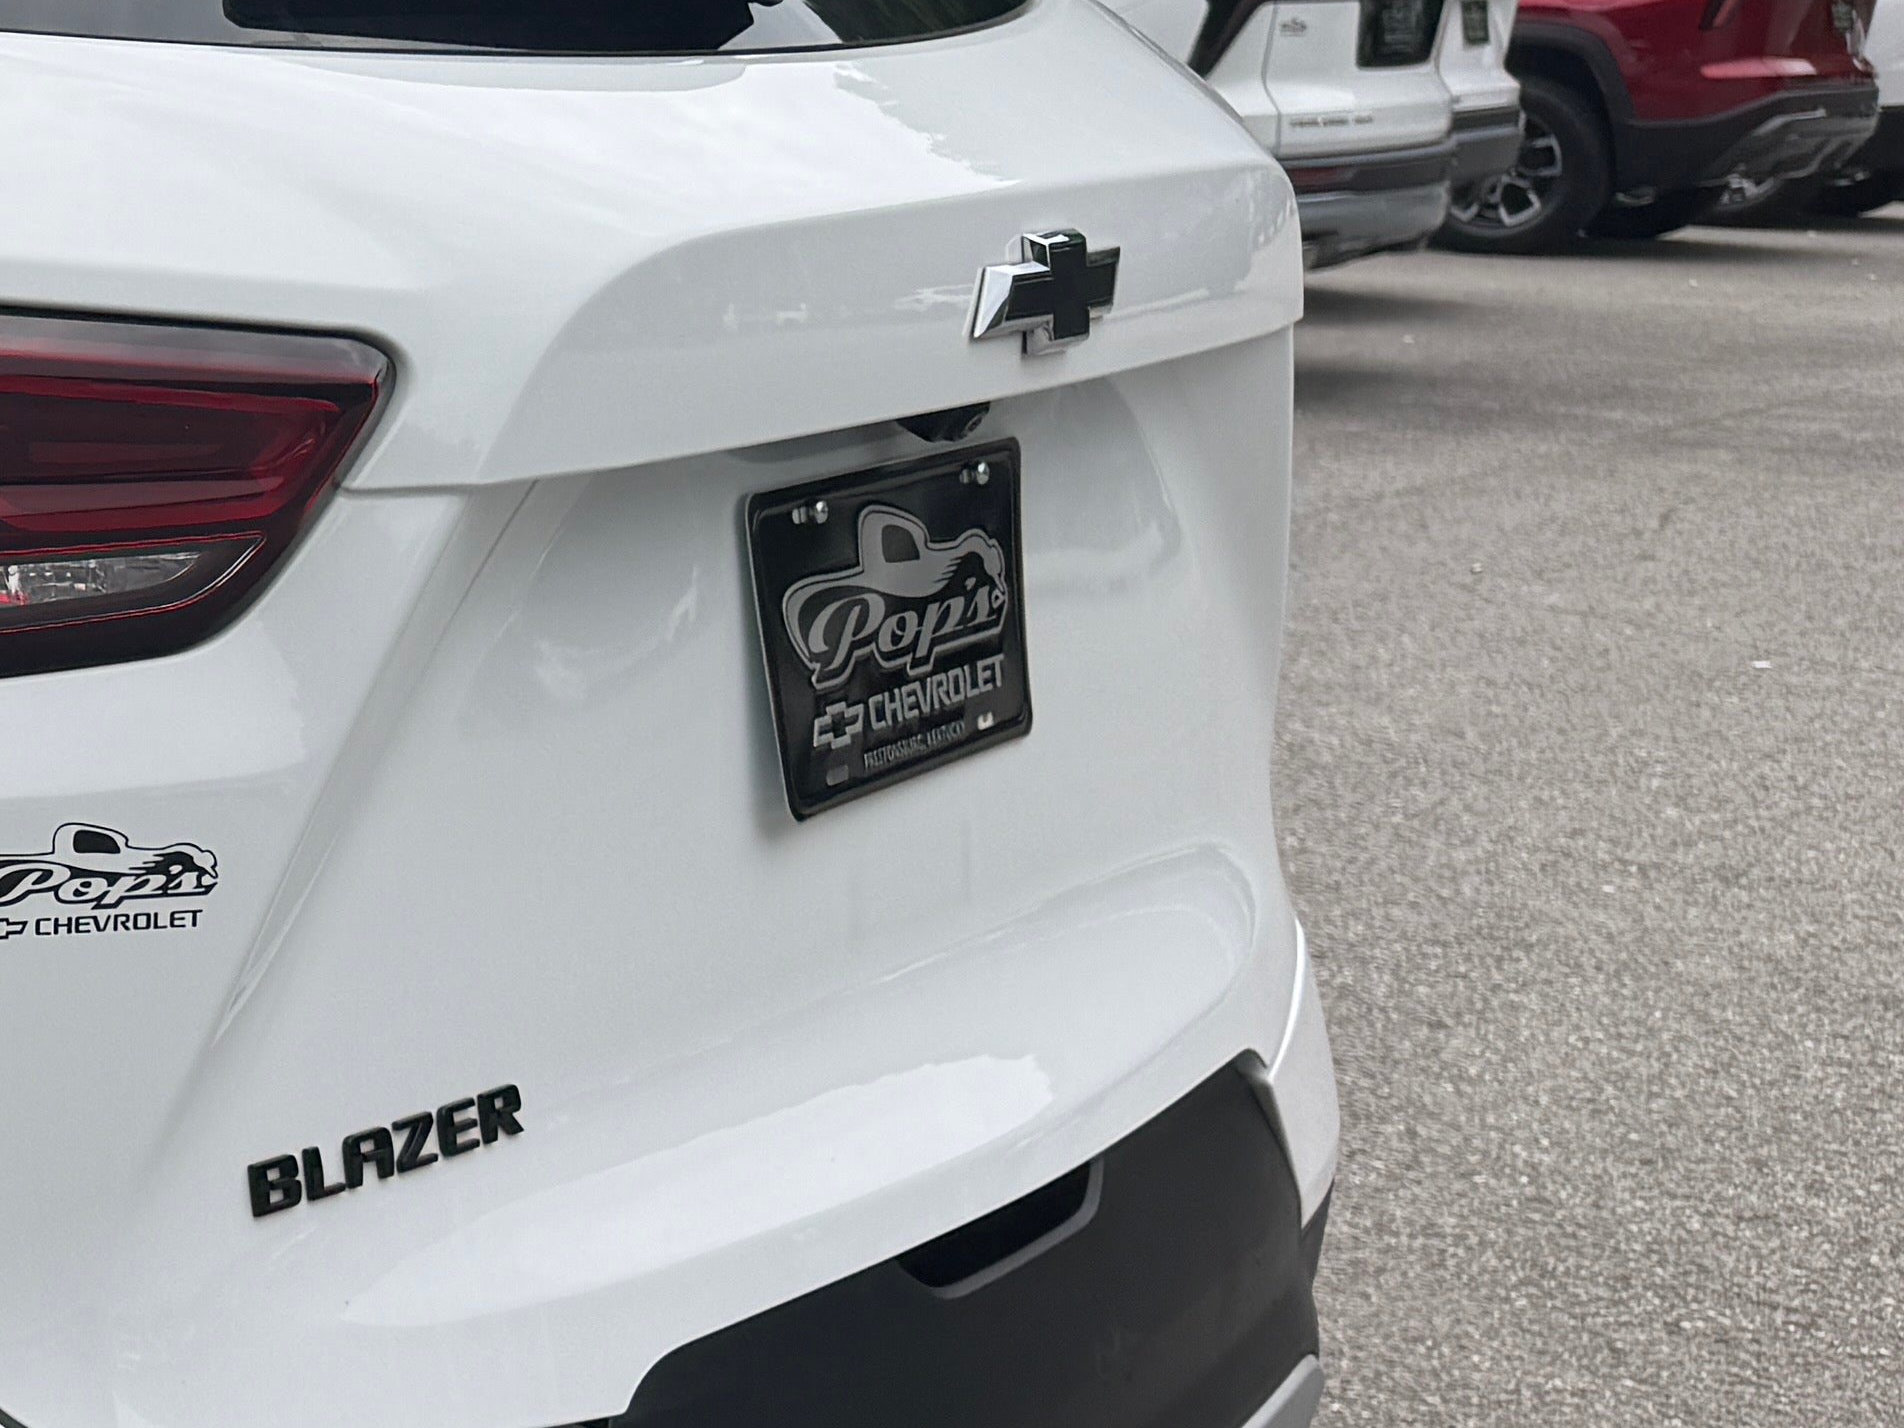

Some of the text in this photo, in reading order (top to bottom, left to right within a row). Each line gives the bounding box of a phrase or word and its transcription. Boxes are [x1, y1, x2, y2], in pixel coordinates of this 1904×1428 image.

[808, 575, 998, 672] Pop's
[870, 653, 1005, 731] CHEVROLET
[35, 909, 203, 936] CHEVROLET
[247, 1083, 524, 1218] BLAZER
